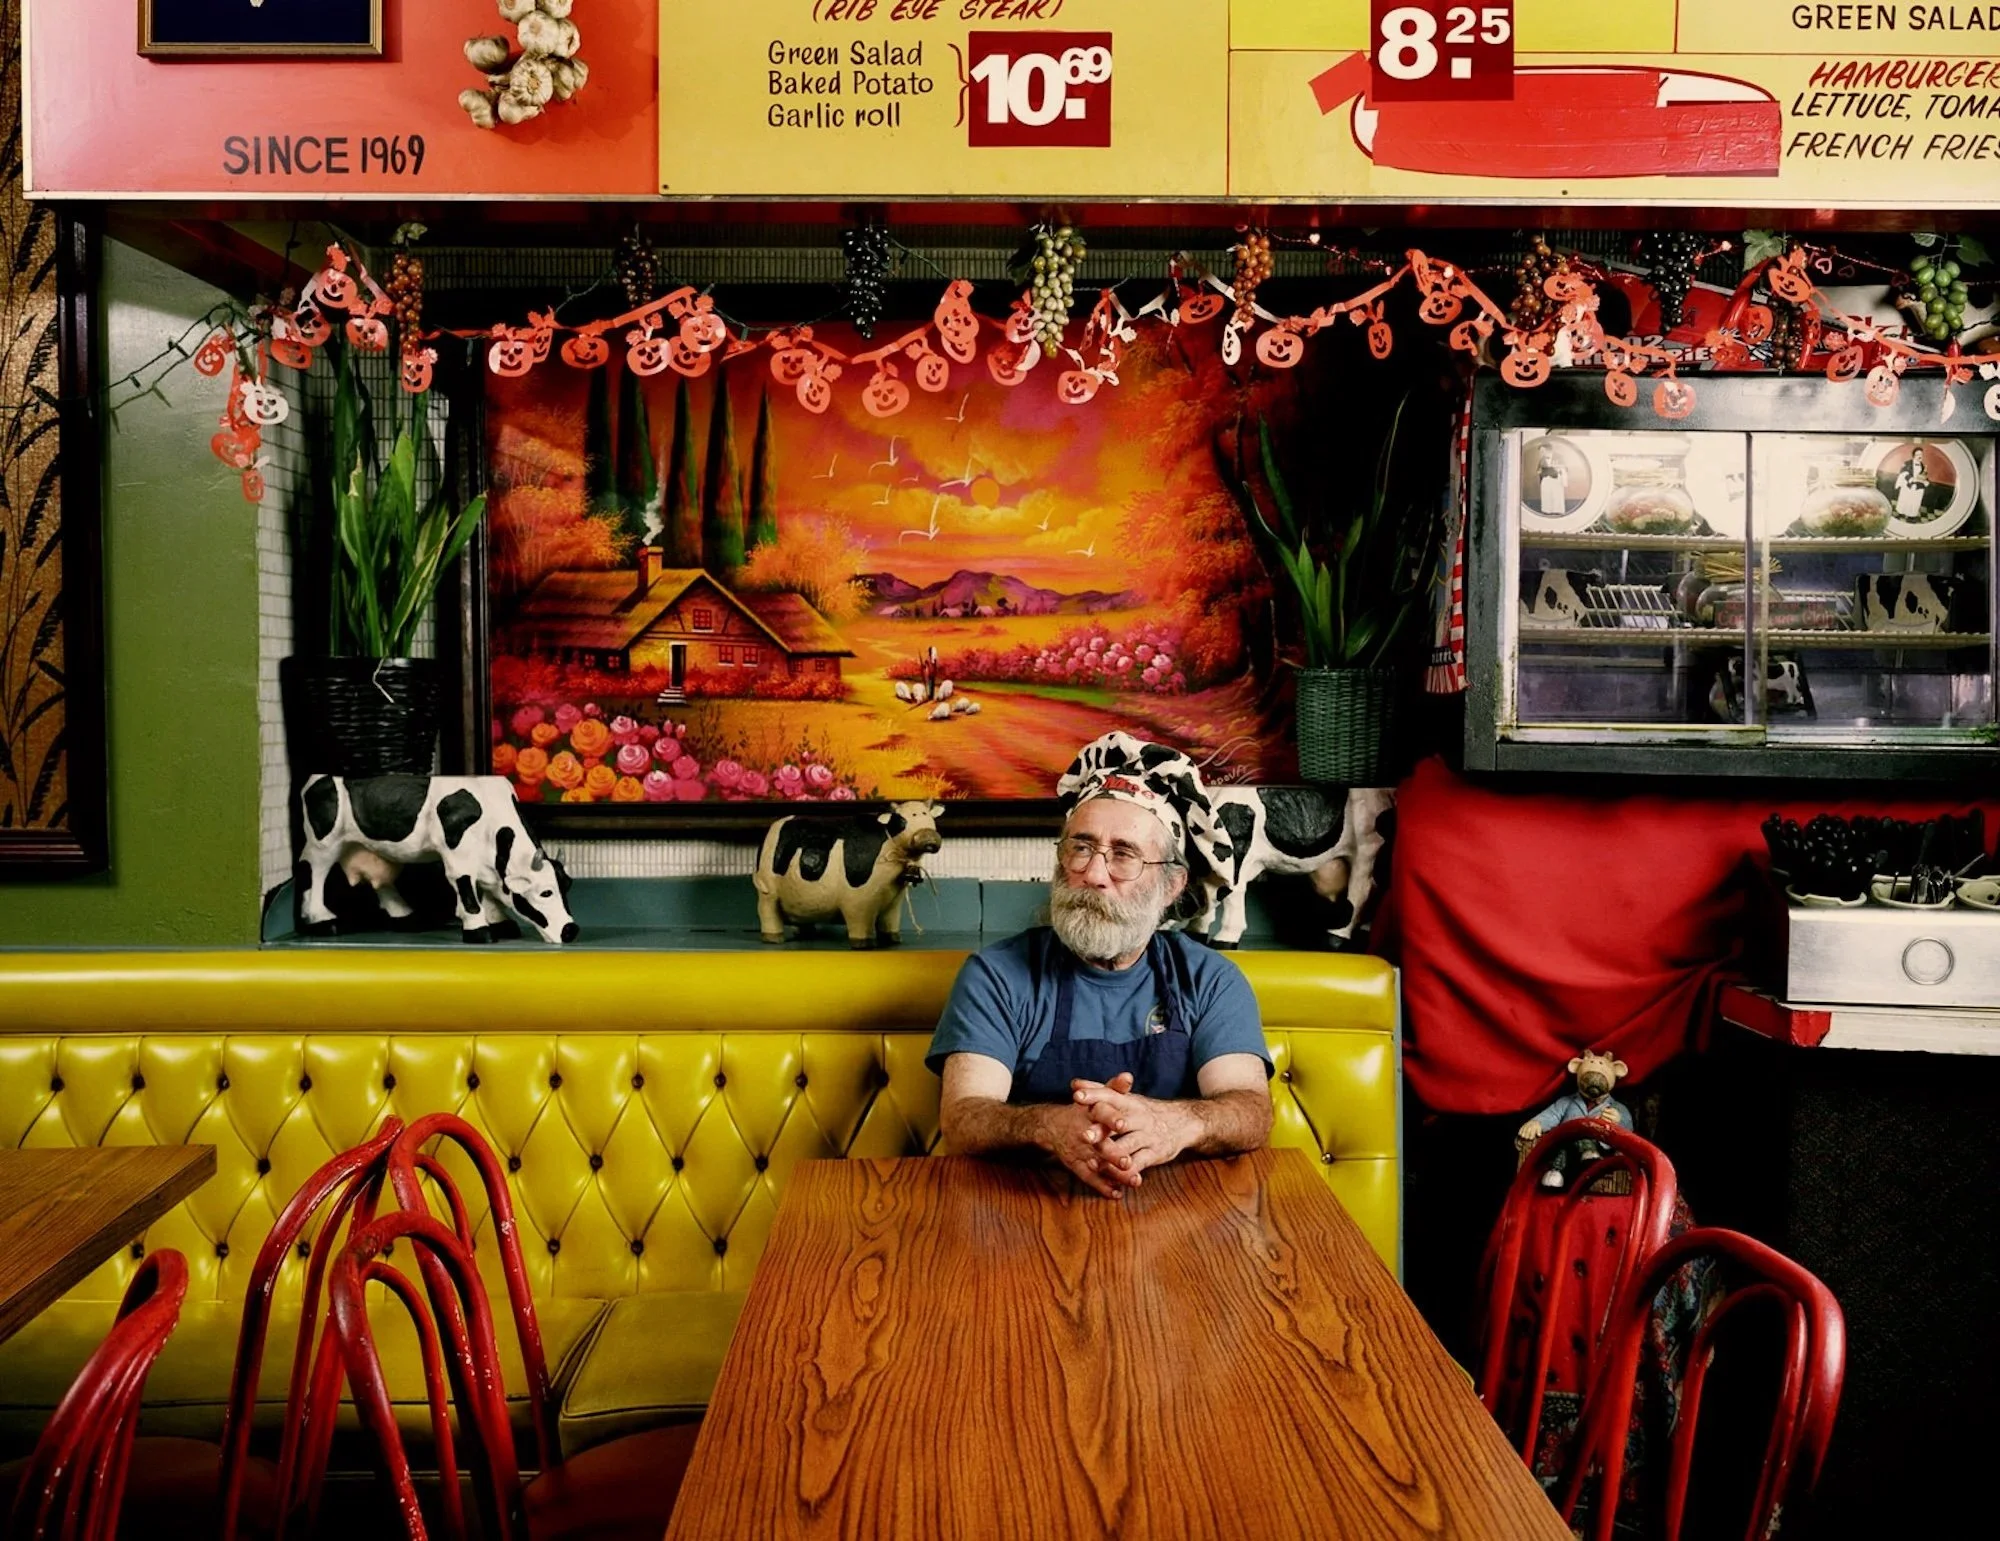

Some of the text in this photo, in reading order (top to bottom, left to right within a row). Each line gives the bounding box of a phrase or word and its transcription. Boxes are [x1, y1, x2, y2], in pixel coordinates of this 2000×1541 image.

[813, 0, 1063, 23] (RIB EYE STEAK)
[1792, 4, 1896, 30] GREEN
[767, 40, 922, 66] Green Salad
[1378, 7, 1511, 80] 8.25
[768, 71, 934, 95] Baked Potato
[970, 46, 1113, 126] 10.69
[767, 102, 901, 128] Garlic roll
[1791, 92, 1912, 121] LETTUCE,
[223, 134, 425, 175] SINCE 1969
[1786, 132, 1914, 160] FRENCH
